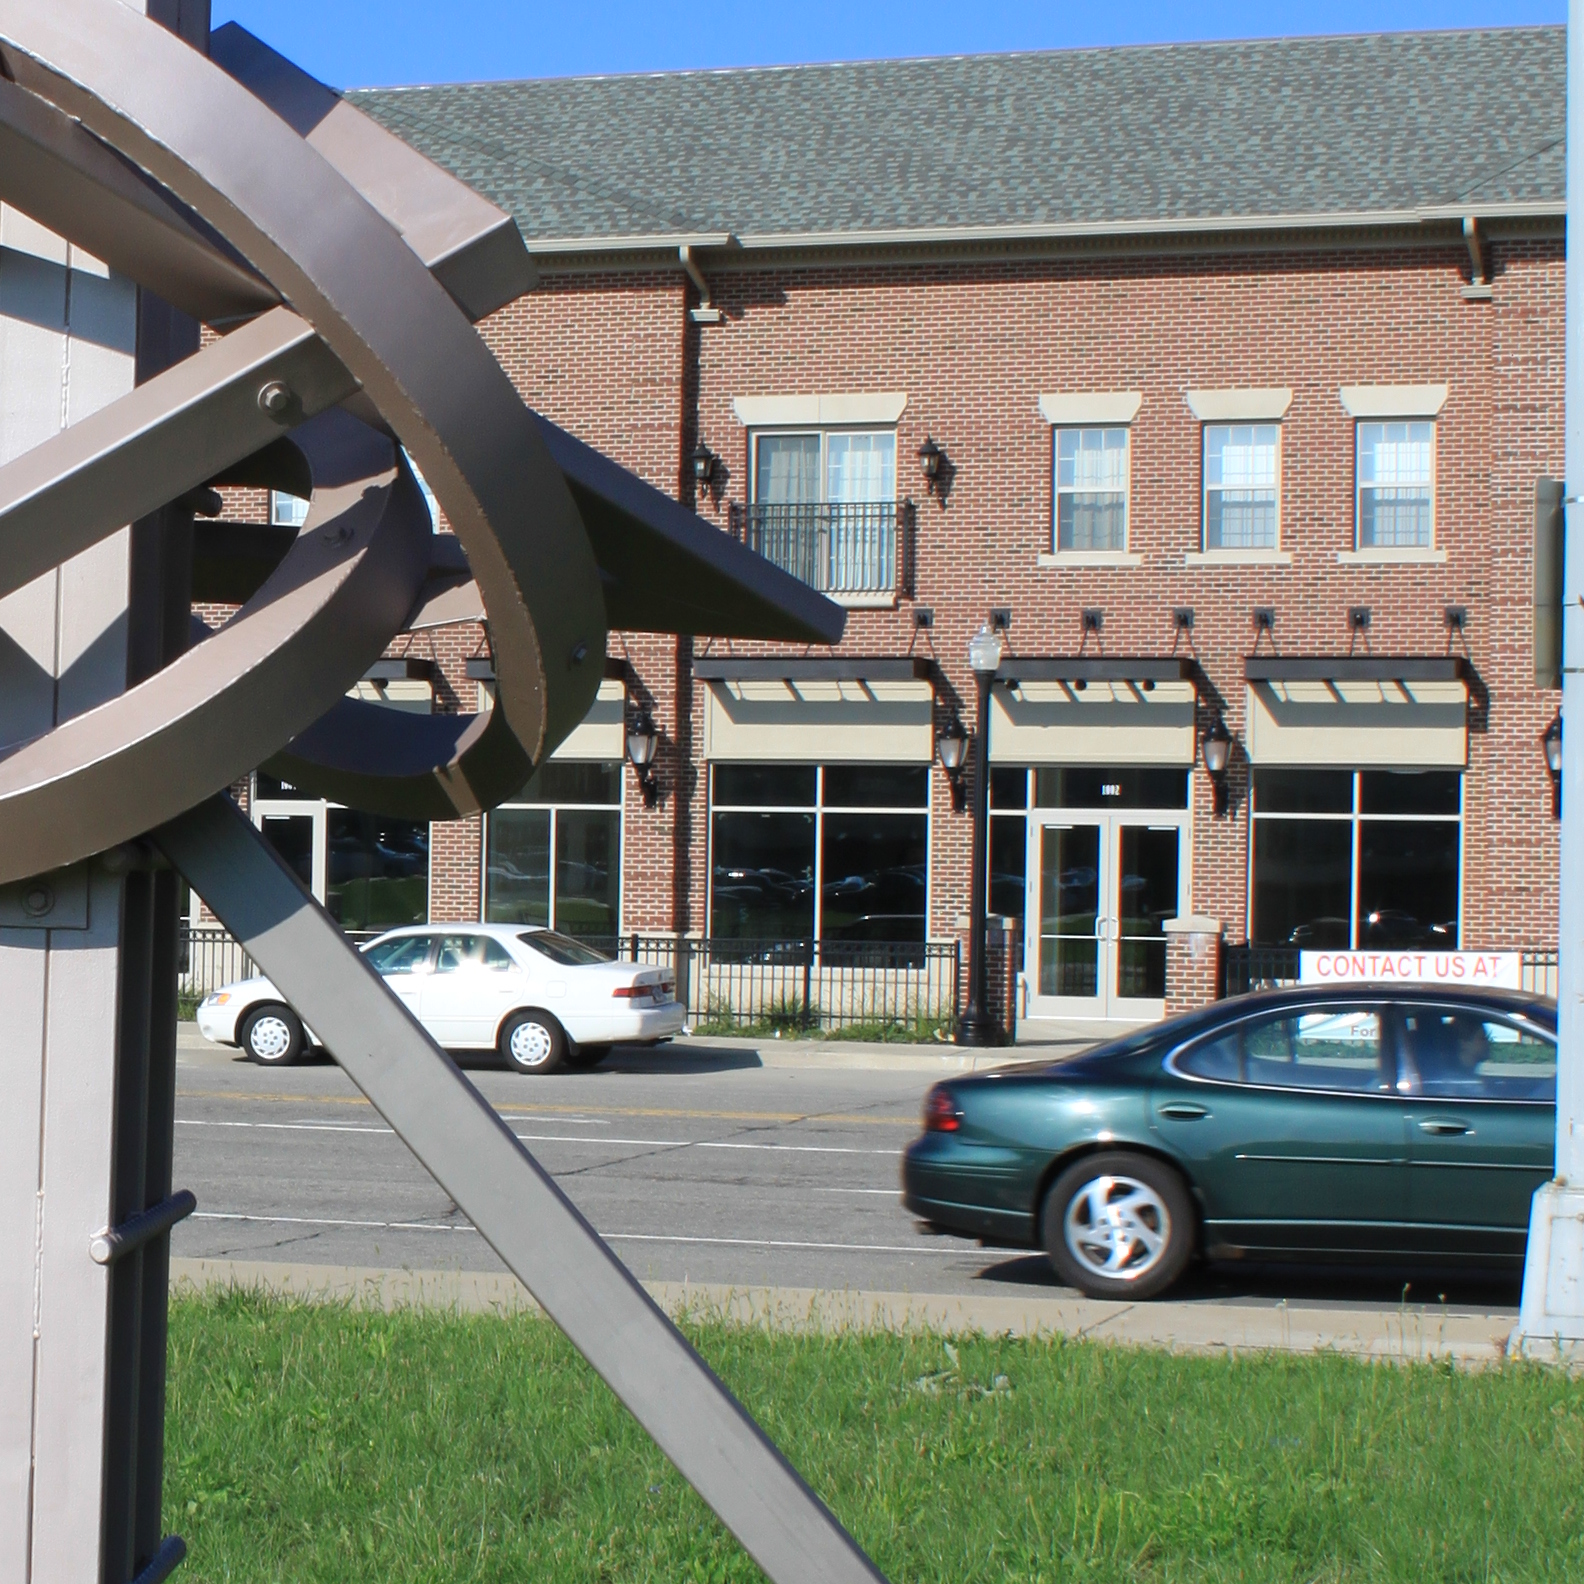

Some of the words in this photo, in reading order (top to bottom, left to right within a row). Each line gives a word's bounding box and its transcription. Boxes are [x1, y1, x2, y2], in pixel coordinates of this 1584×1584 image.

[1316, 954, 1426, 978] CONTACT
[1434, 955, 1466, 978] US
[1472, 956, 1502, 978] AT
[1350, 1024, 1376, 1038] For
